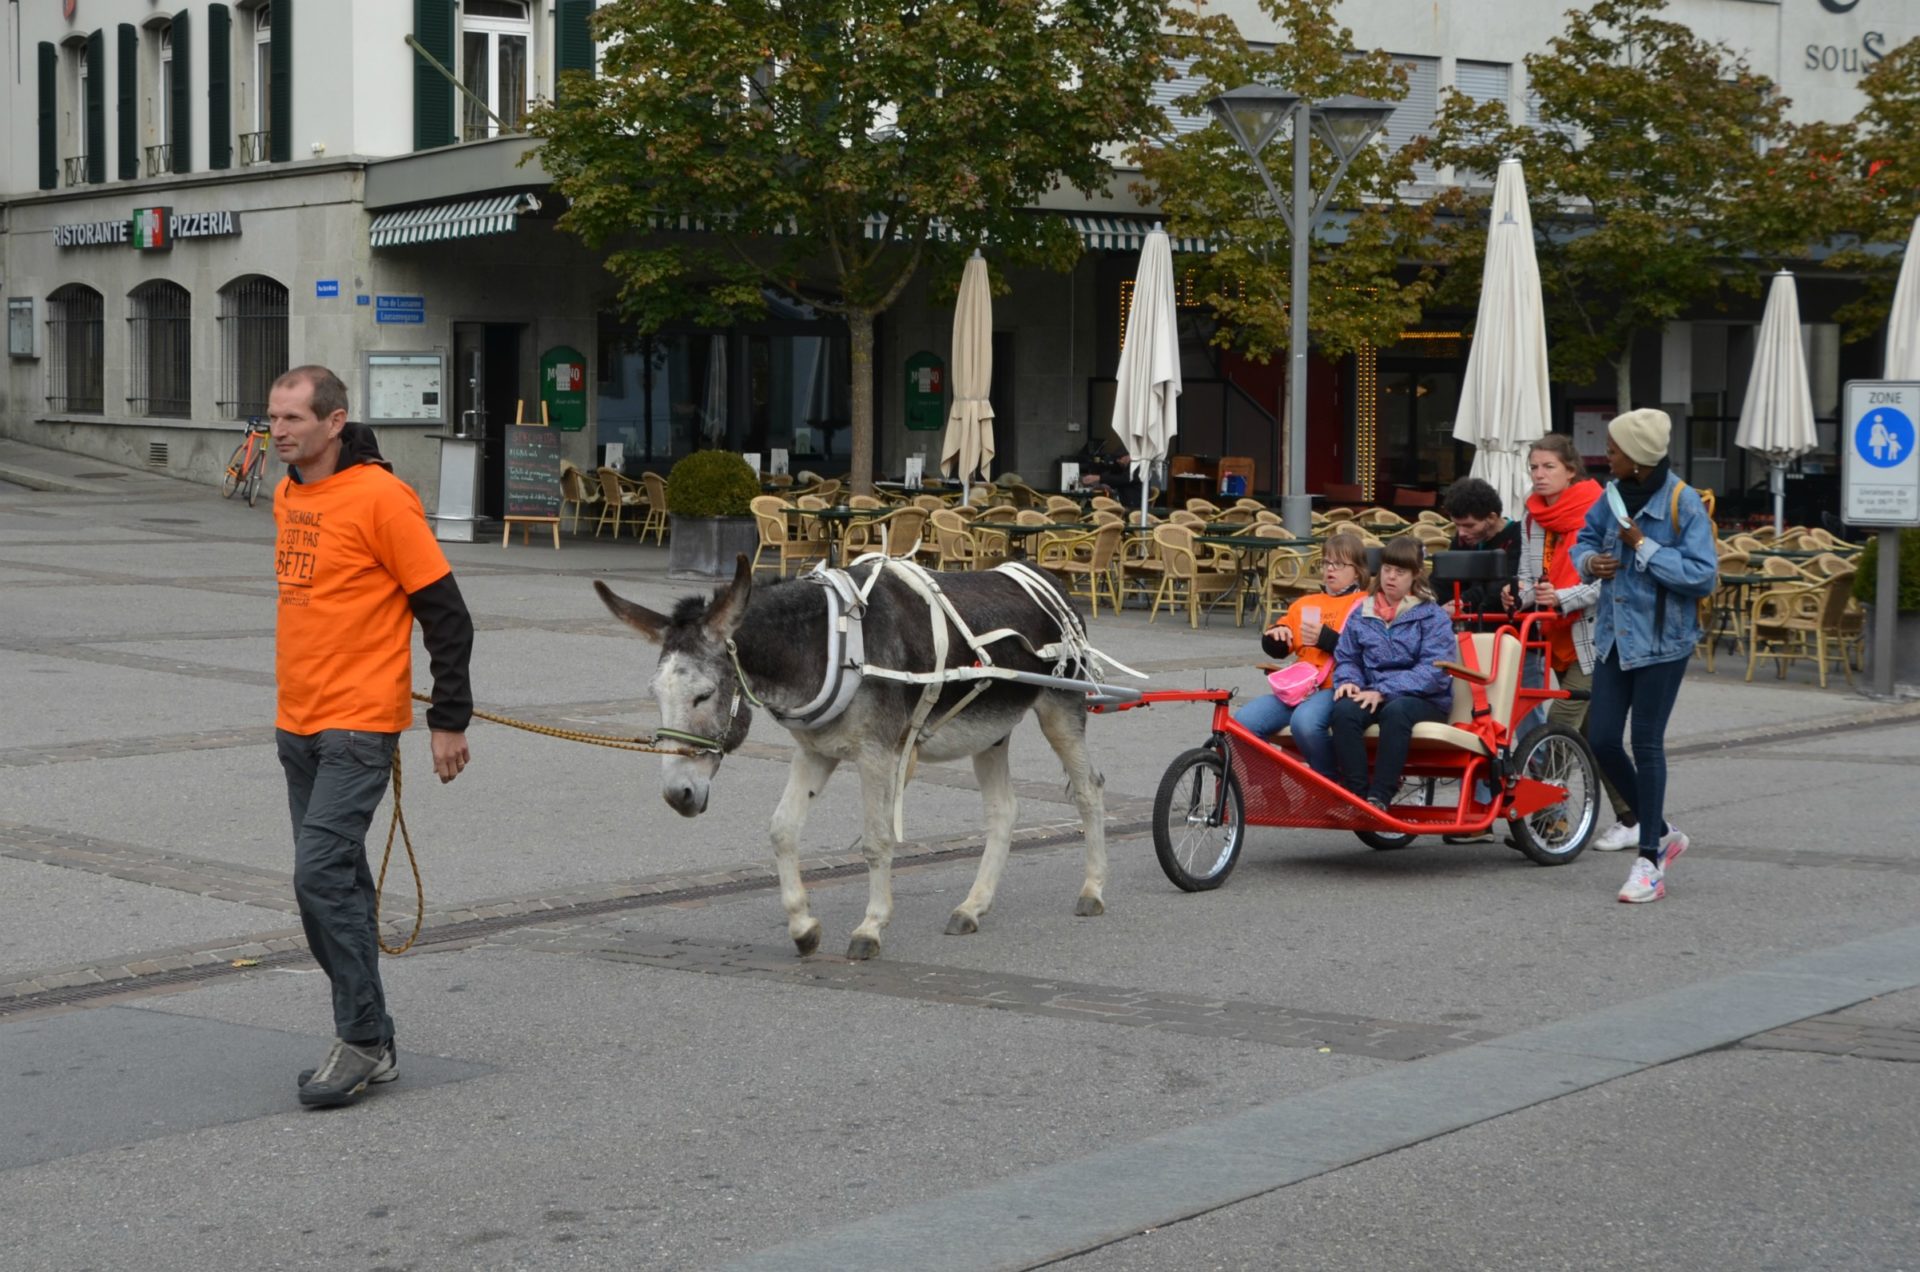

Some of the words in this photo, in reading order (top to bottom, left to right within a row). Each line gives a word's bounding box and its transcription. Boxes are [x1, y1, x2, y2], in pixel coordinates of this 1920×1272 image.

[52, 220, 128, 247] RISTORANTE
[169, 211, 233, 238] PIZZERIA
[1868, 391, 1902, 404] ZONE
[303, 530, 320, 548] PAS
[276, 545, 316, 580] BÊTE!
